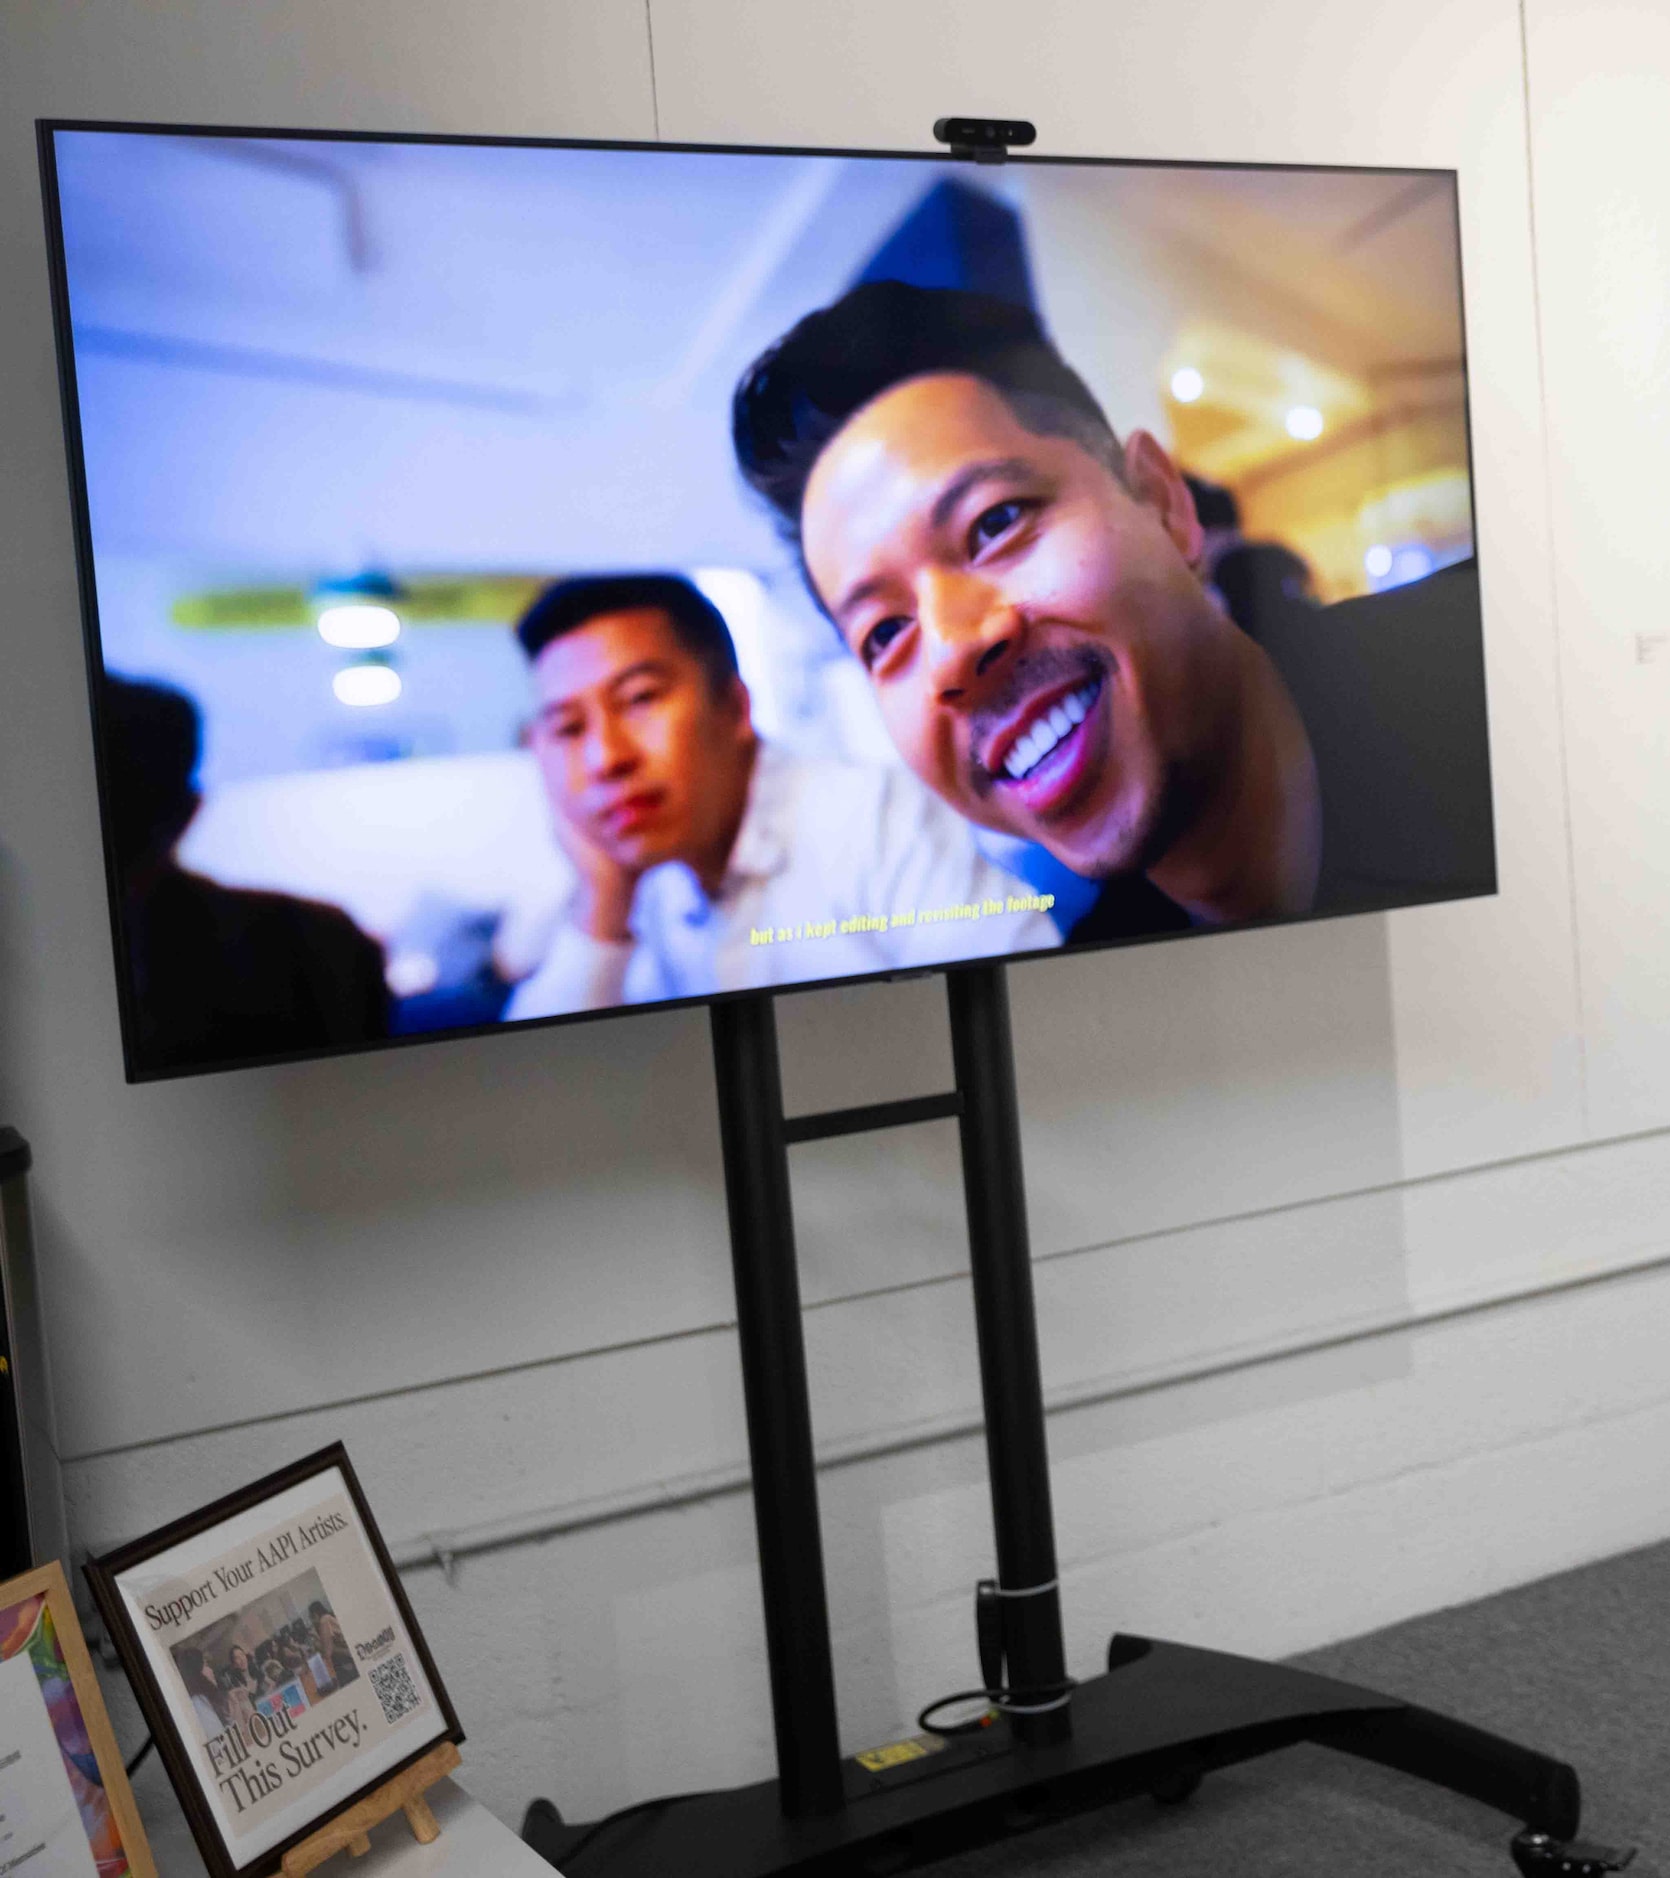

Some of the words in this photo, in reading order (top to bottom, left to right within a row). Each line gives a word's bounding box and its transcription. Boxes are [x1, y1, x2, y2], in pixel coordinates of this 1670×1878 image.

[750, 927, 774, 946] but
[777, 926, 793, 942] as
[806, 919, 836, 939] kept
[839, 914, 888, 934] editing
[891, 908, 915, 928] and
[918, 902, 979, 922] revisiting
[982, 898, 1004, 915] the
[1007, 893, 1055, 913] footage
[144, 1579, 217, 1631] Support
[213, 1559, 255, 1593] Your
[255, 1531, 299, 1574] AAPI
[297, 1511, 349, 1551] Artists.
[203, 1722, 252, 1779] Fill
[249, 1705, 298, 1749] Out
[219, 1760, 284, 1814] This
[279, 1708, 369, 1778] Survey.
